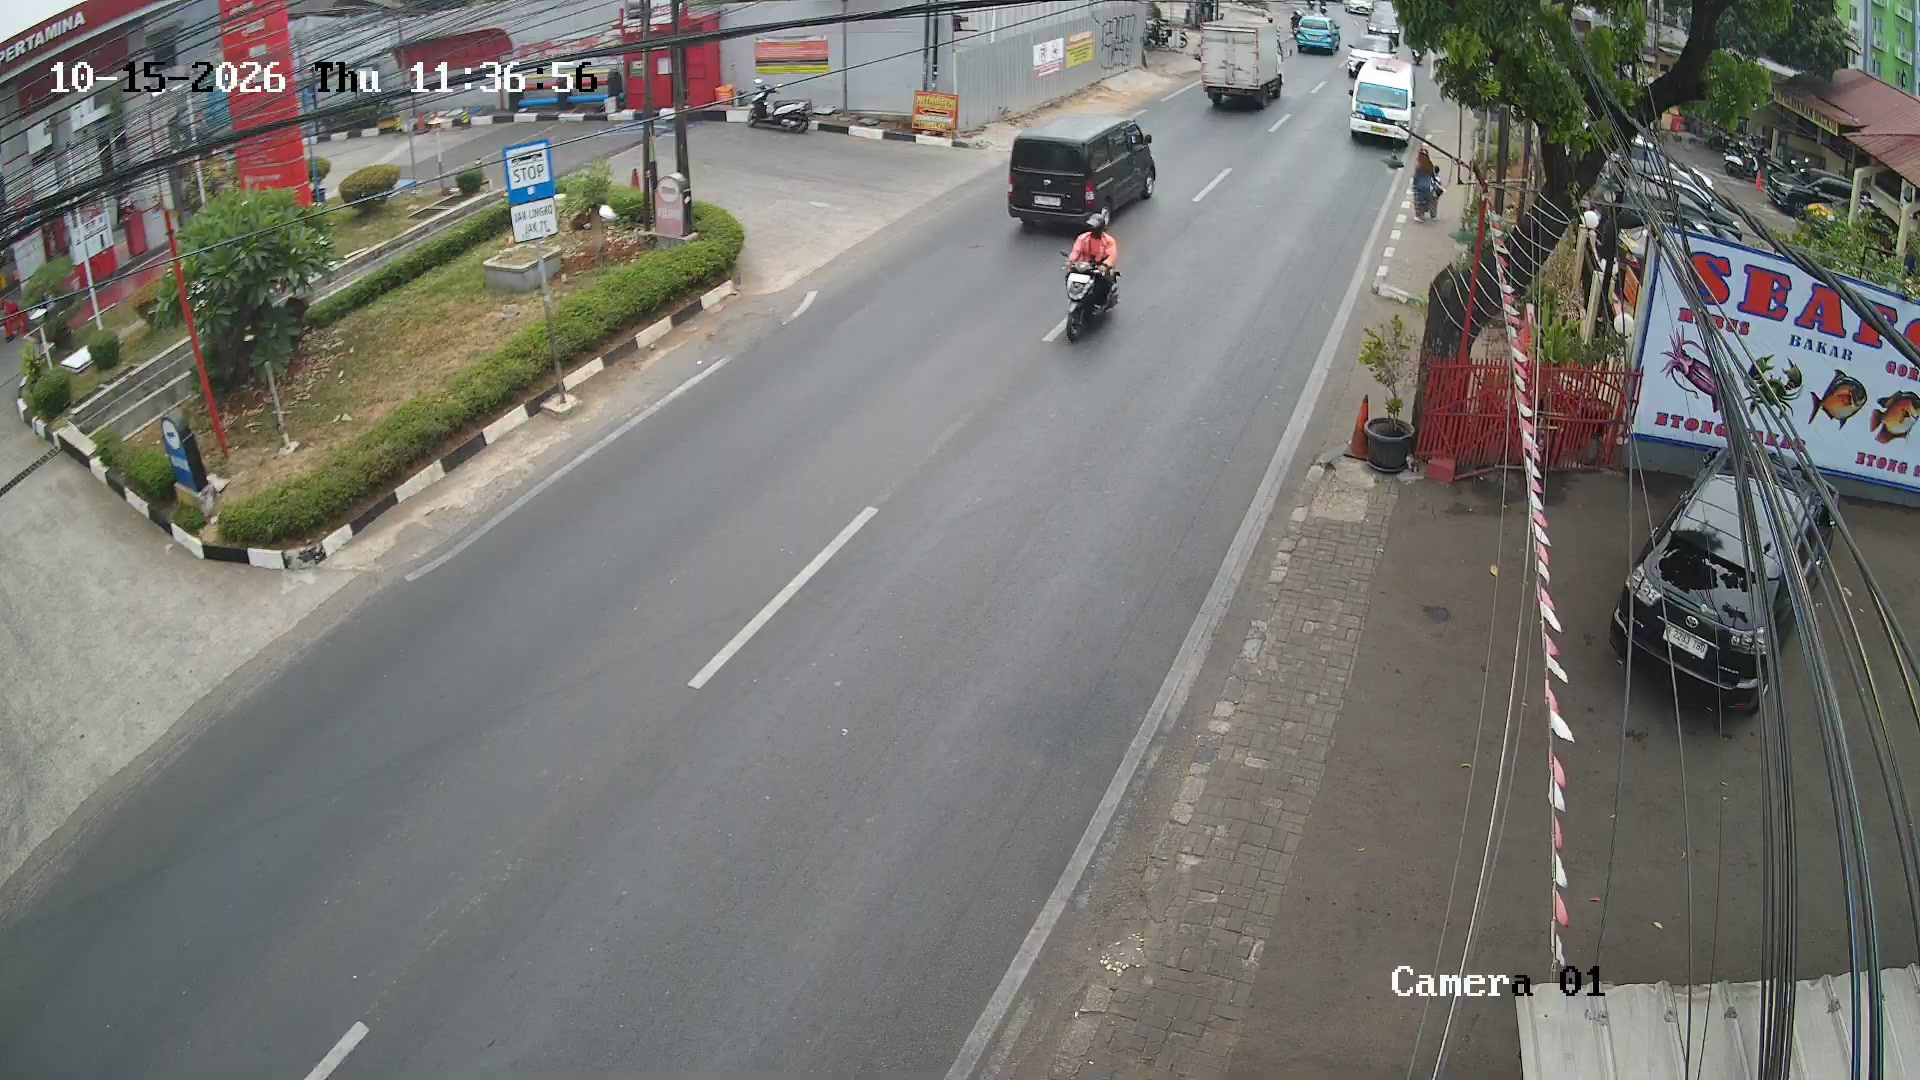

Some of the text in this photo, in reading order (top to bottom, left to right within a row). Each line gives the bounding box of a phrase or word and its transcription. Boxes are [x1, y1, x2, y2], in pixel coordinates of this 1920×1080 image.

[0, 11, 86, 64] PERTAMINA
[512, 164, 544, 183] STOP
[1789, 334, 1853, 361] BAKAR
